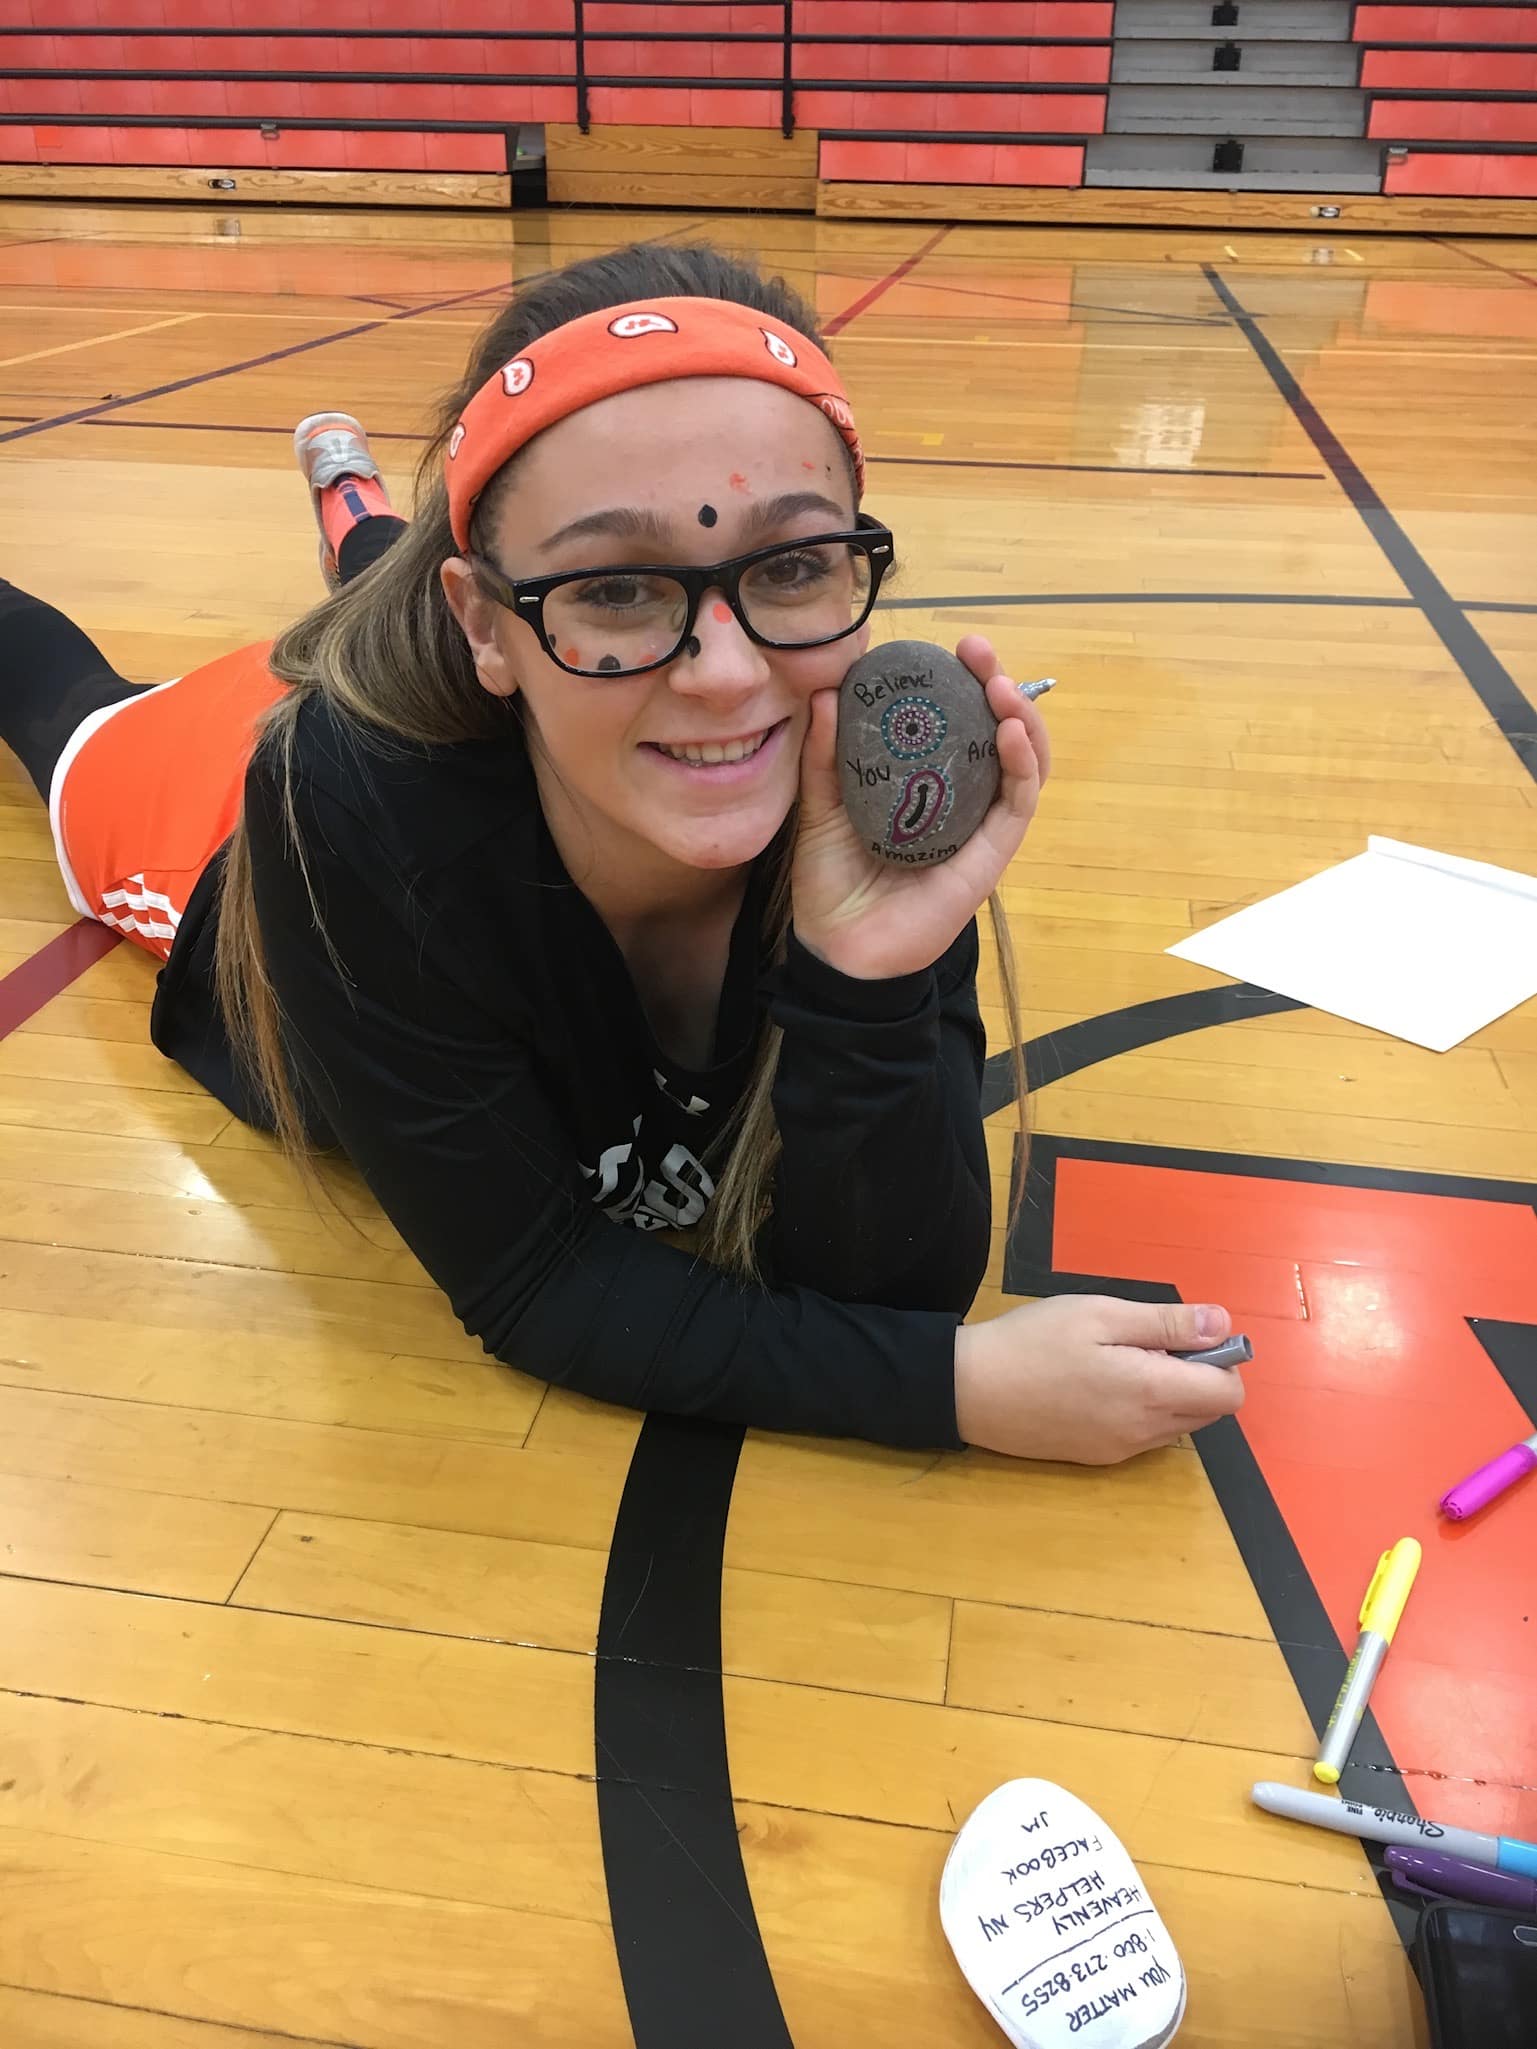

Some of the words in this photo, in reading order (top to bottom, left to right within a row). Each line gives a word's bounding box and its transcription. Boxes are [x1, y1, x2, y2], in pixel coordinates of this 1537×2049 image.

[853, 669, 934, 708] Believe!
[846, 758, 891, 788] You
[967, 739, 998, 764] Are
[871, 842, 961, 865] Amazing
[1020, 1810, 1049, 1833] JM
[1001, 1835, 1103, 1885] FACEBOOK
[1013, 1870, 1106, 1923] HELPERS
[1052, 1884, 1143, 1936] HEAVENLY
[978, 1914, 1009, 1942] NY
[1065, 1982, 1138, 2033] MATTER
